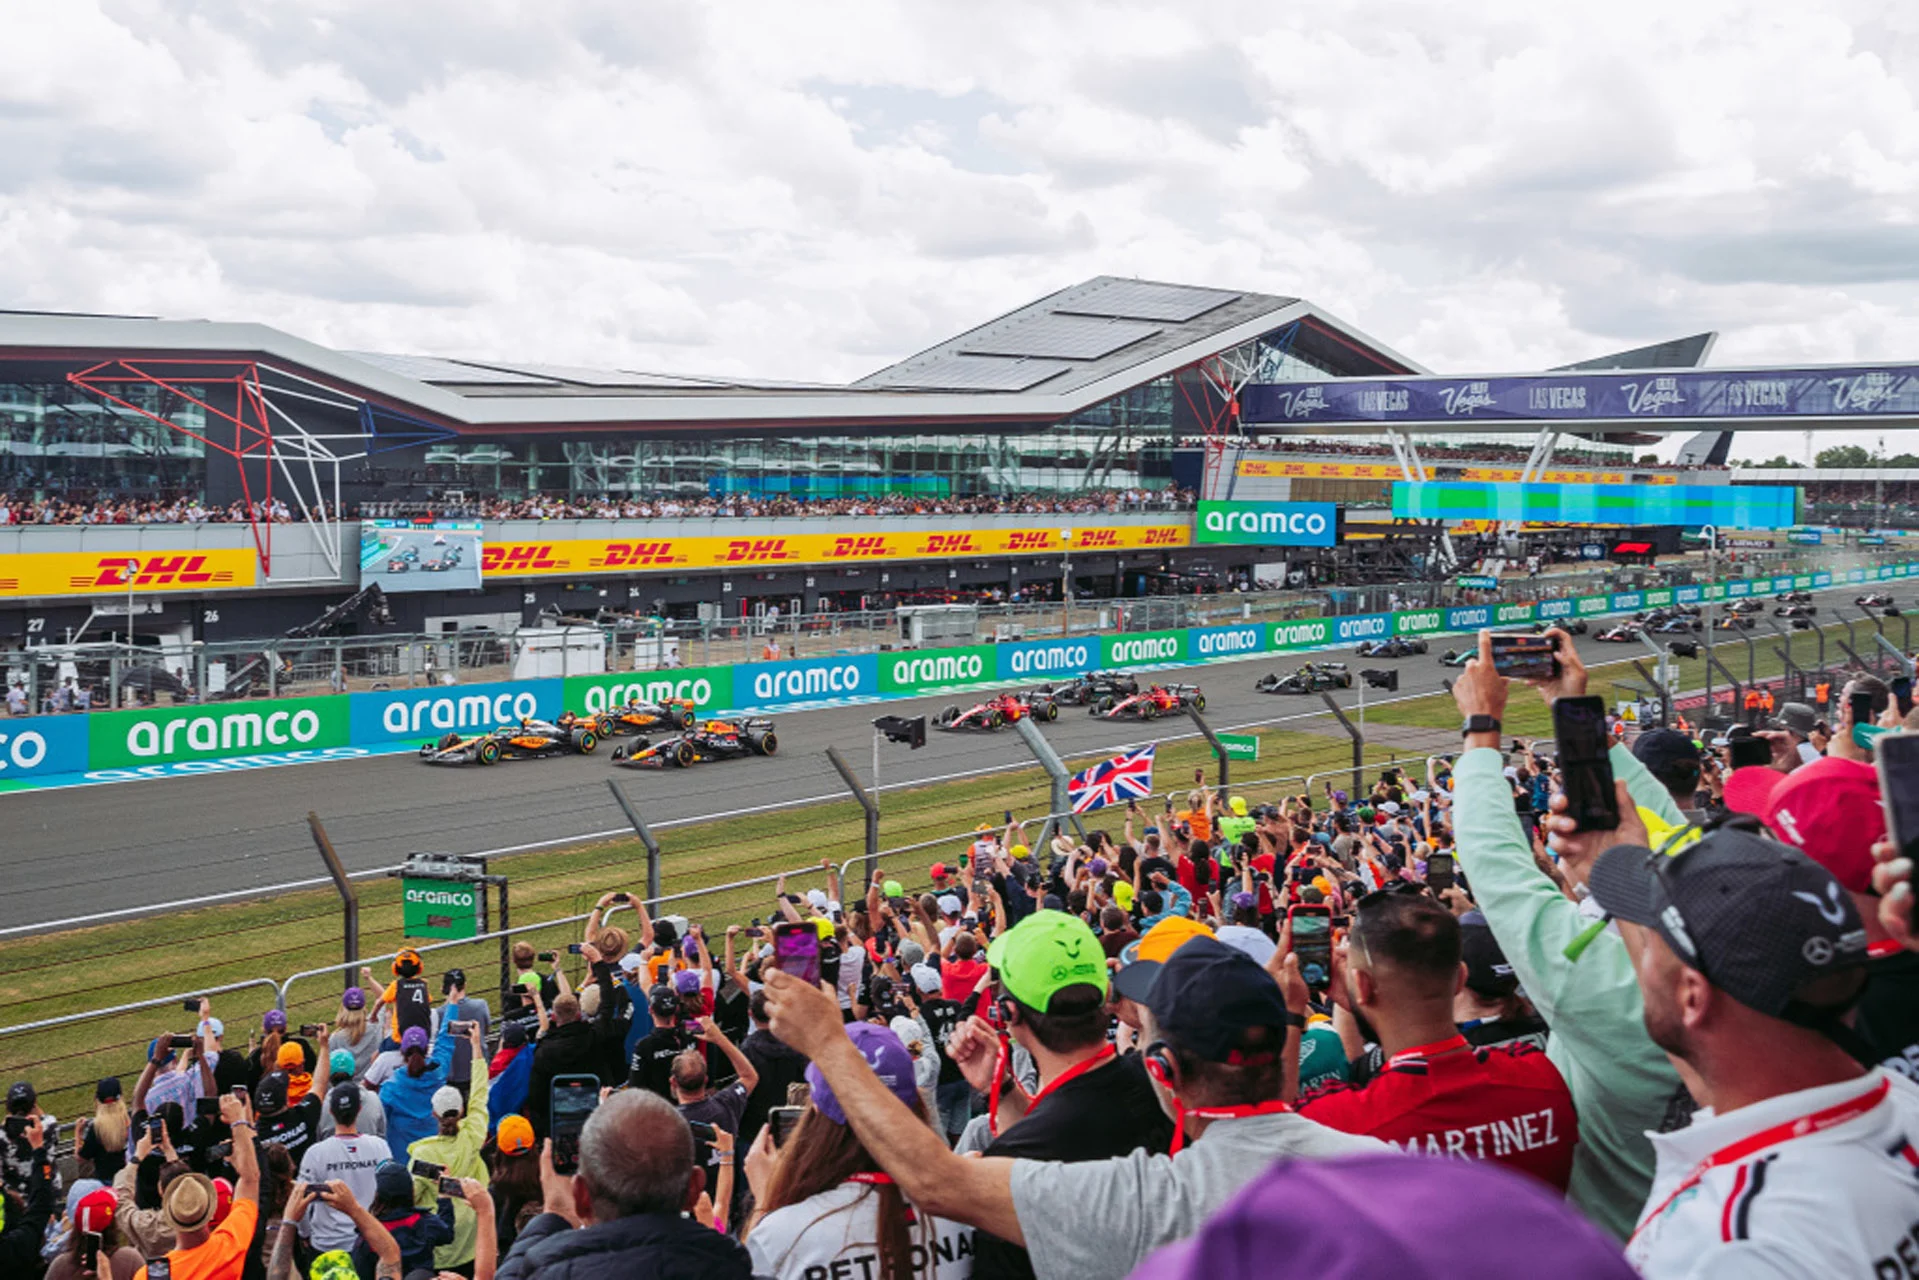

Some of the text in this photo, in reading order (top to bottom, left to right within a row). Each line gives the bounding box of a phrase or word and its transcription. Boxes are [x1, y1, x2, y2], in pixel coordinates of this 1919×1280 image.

[1438, 385, 1497, 415] Vegas
[1620, 380, 1686, 413] Vegas
[1205, 511, 1326, 535] aramco
[833, 537, 887, 556] DHL
[926, 534, 974, 552] DHL
[1007, 532, 1050, 549] DHL
[1080, 530, 1118, 547] DHL
[1144, 528, 1178, 544] DHL
[482, 546, 555, 570] DHL
[604, 543, 675, 565] DHL
[727, 540, 788, 561] DHL
[95, 556, 213, 586] DHL
[27, 618, 45, 632] 27
[204, 611, 219, 623] 26
[1339, 617, 1385, 638] aramco
[1399, 612, 1440, 631] aramco
[1199, 629, 1256, 653] aramco
[1274, 623, 1325, 645] aramco
[1011, 646, 1087, 673] aramco
[1112, 637, 1177, 663] aramco
[754, 665, 860, 698] aramco
[893, 655, 982, 685] aramco
[585, 678, 712, 714] aramco
[383, 692, 537, 734] aramco
[127, 709, 320, 756] aramco
[84, 747, 369, 780] aramco
[406, 889, 472, 906] aramco
[412, 988, 424, 1003] 4
[326, 1159, 378, 1172] PETRONAS
[805, 1230, 978, 1280] PETONA
